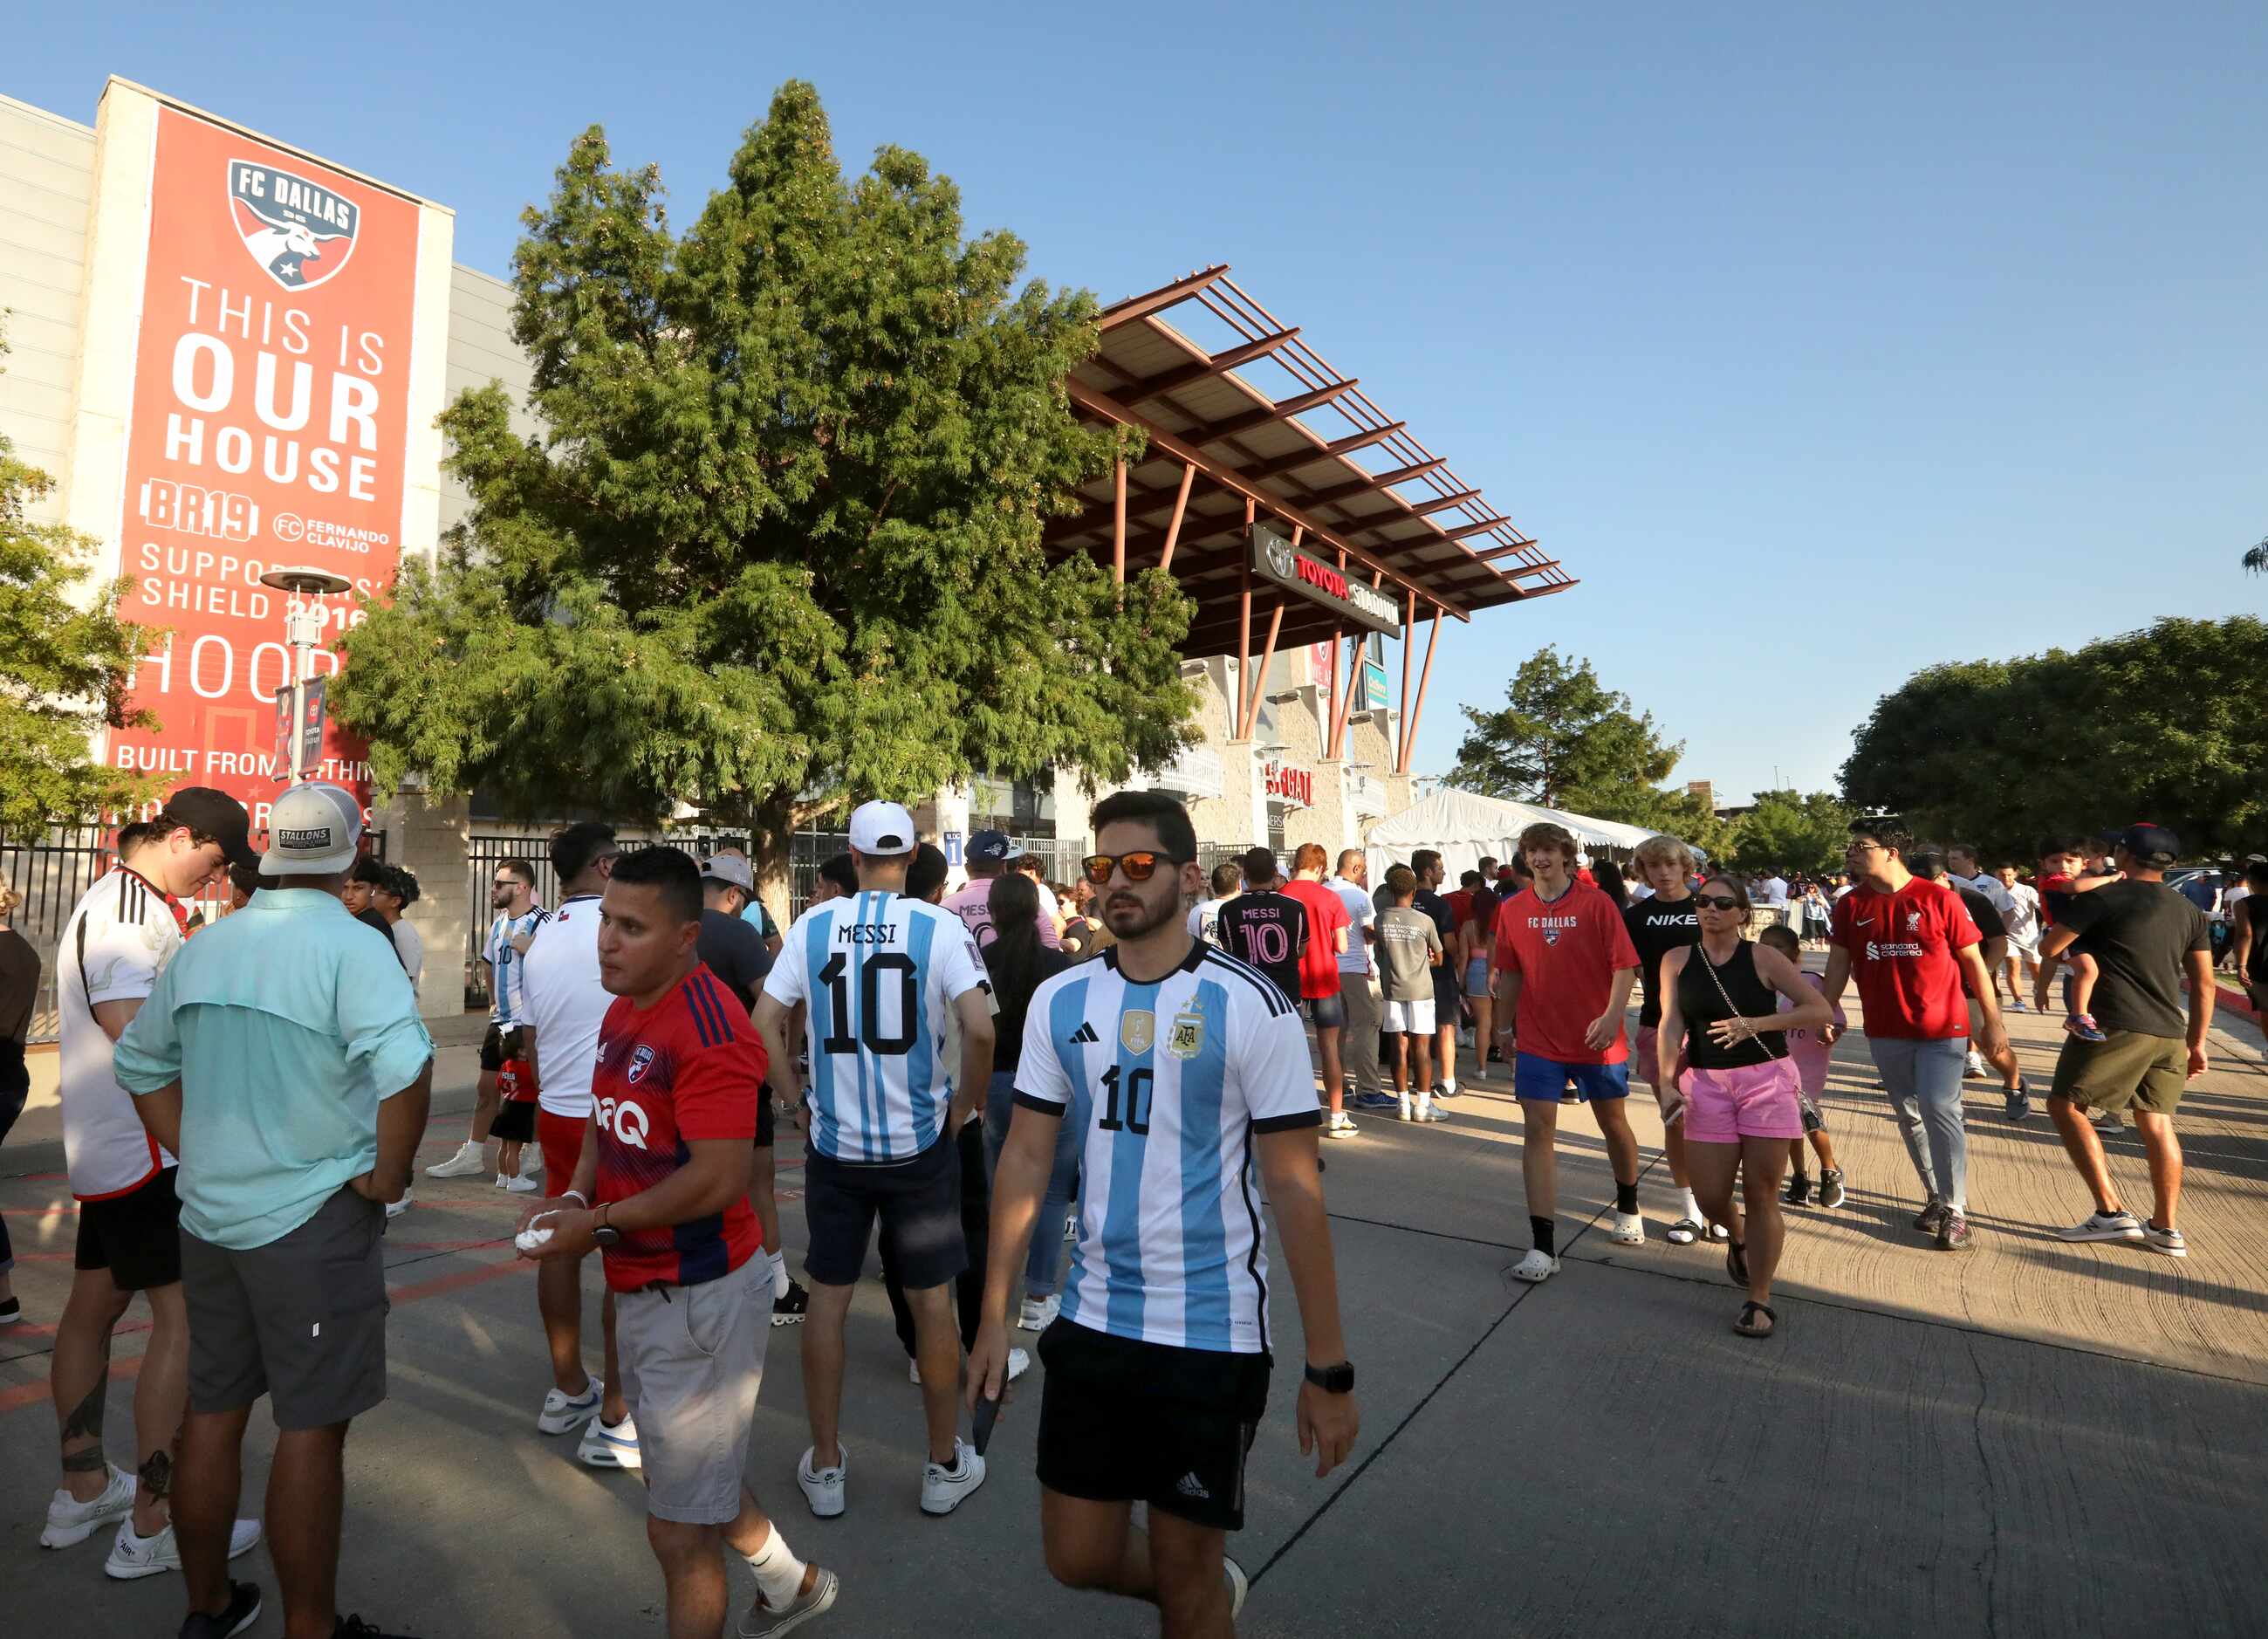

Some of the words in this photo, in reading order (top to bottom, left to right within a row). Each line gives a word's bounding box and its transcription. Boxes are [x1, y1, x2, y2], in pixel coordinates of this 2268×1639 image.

[239, 168, 265, 197] FC
[274, 176, 350, 230] DALLAS
[181, 276, 311, 355] THIS
[339, 324, 384, 375] IS
[172, 332, 380, 451] OUR
[164, 413, 376, 502] HOUSE
[142, 477, 257, 542] BR19
[307, 519, 389, 545] FERNANDO
[307, 531, 370, 554] CLAVIJO
[141, 578, 269, 621] SHIELD
[1293, 553, 1349, 600] TOYOTA
[1348, 583, 1400, 626] STADIUM
[117, 744, 198, 771] BUILT
[206, 751, 277, 778] FROM
[280, 829, 327, 840] STALLONS
[949, 841, 958, 864] 1
[960, 904, 990, 916] MES
[1242, 908, 1280, 920] MESSI
[1528, 917, 1538, 928] FC
[1541, 916, 1577, 928] DALLAS
[1646, 914, 1698, 925] NIKE
[838, 924, 897, 944] MESSI
[1238, 922, 1289, 964] 10
[497, 944, 512, 964] 10
[818, 952, 917, 1055] 10
[1099, 1064, 1154, 1135] 10
